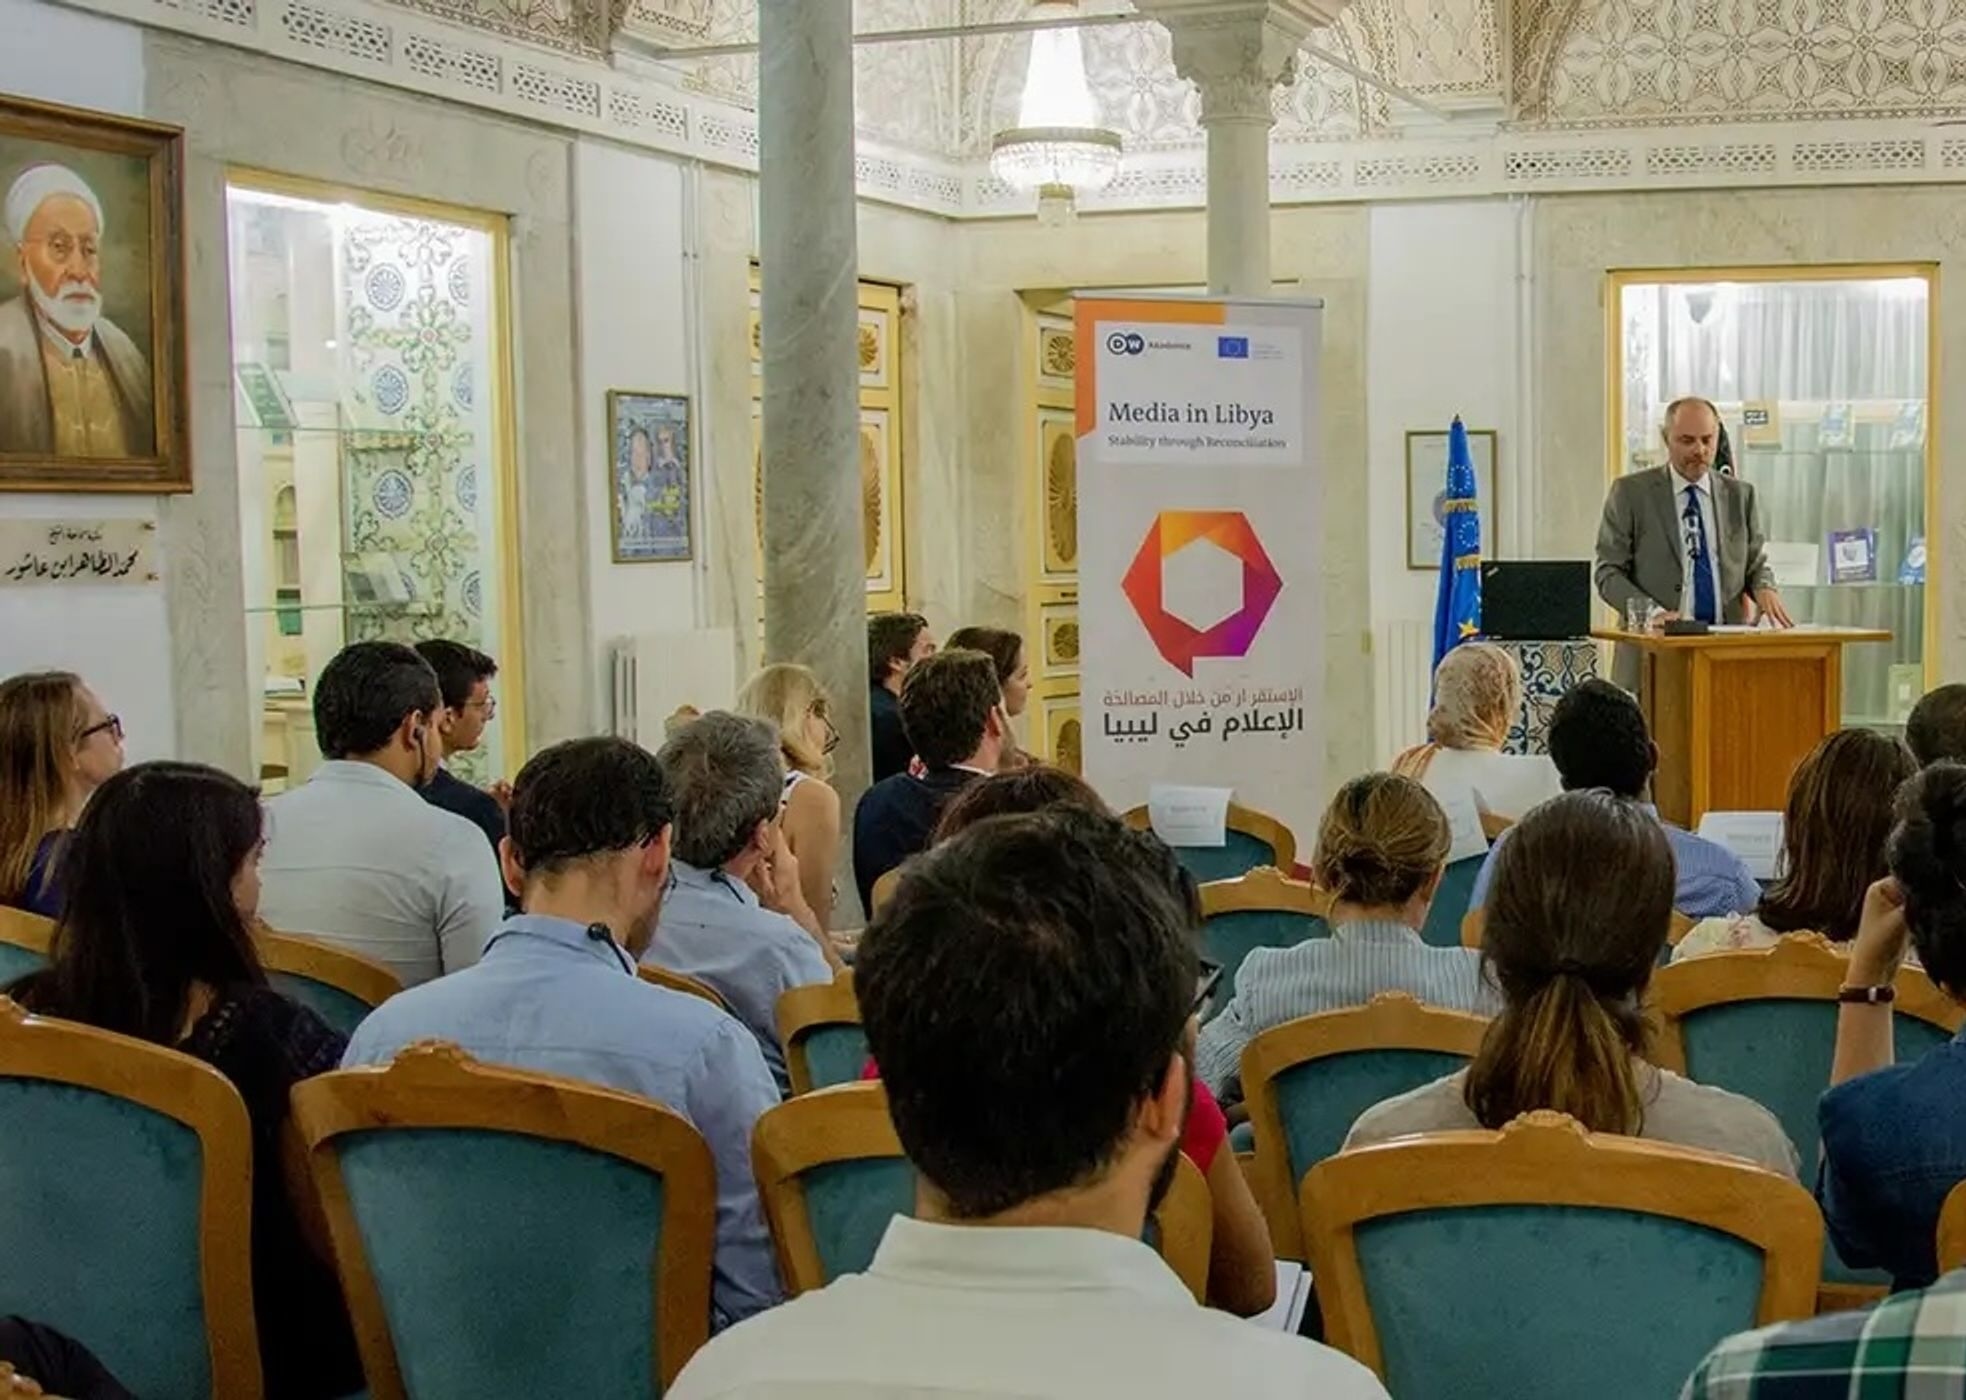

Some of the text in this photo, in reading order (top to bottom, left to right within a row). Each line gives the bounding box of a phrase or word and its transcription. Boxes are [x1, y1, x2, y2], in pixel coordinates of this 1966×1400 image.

[1108, 402, 1274, 430] Media in Libya
[1108, 435, 1287, 450] Stability through Reconciliation
[1210, 690, 1231, 708] من
[1103, 708, 1304, 748] الإعلام في ليبيا
